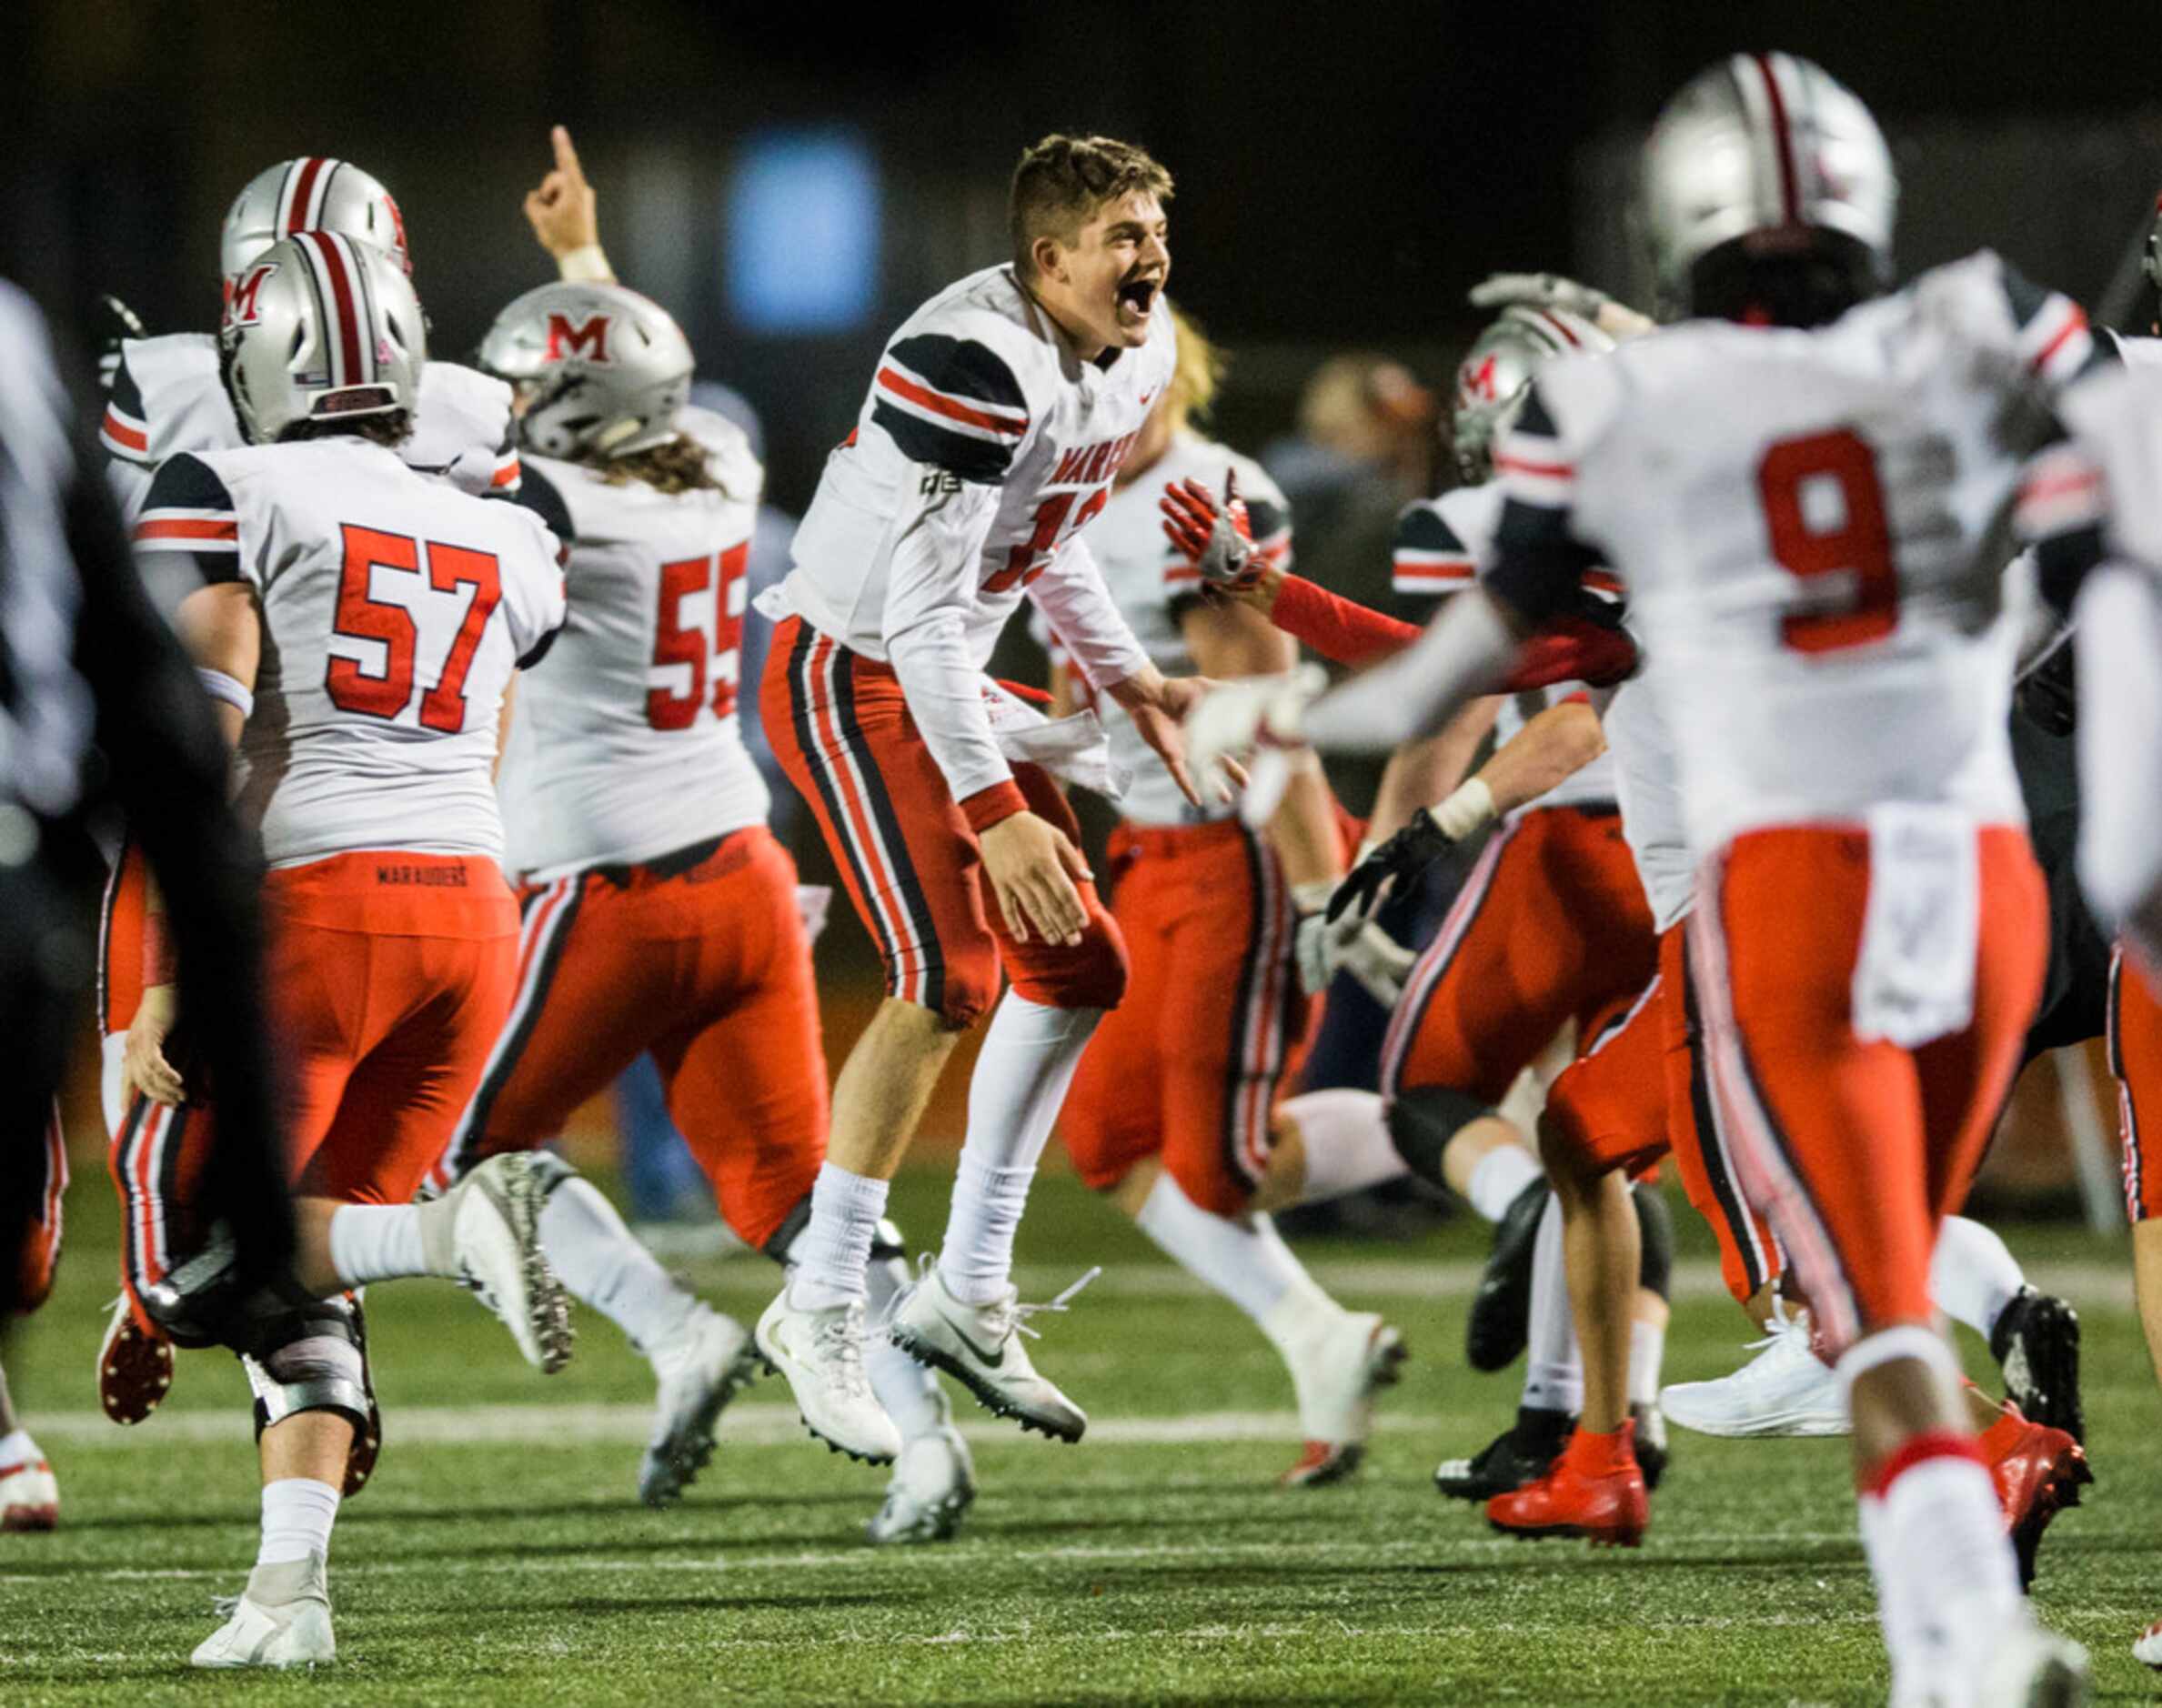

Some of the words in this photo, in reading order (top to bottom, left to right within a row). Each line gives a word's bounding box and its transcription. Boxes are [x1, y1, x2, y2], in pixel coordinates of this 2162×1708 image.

[223, 265, 277, 330] M
[546, 313, 611, 363] M
[325, 522, 502, 735] 57
[646, 540, 749, 731] 55
[1755, 427, 1900, 653] 9
